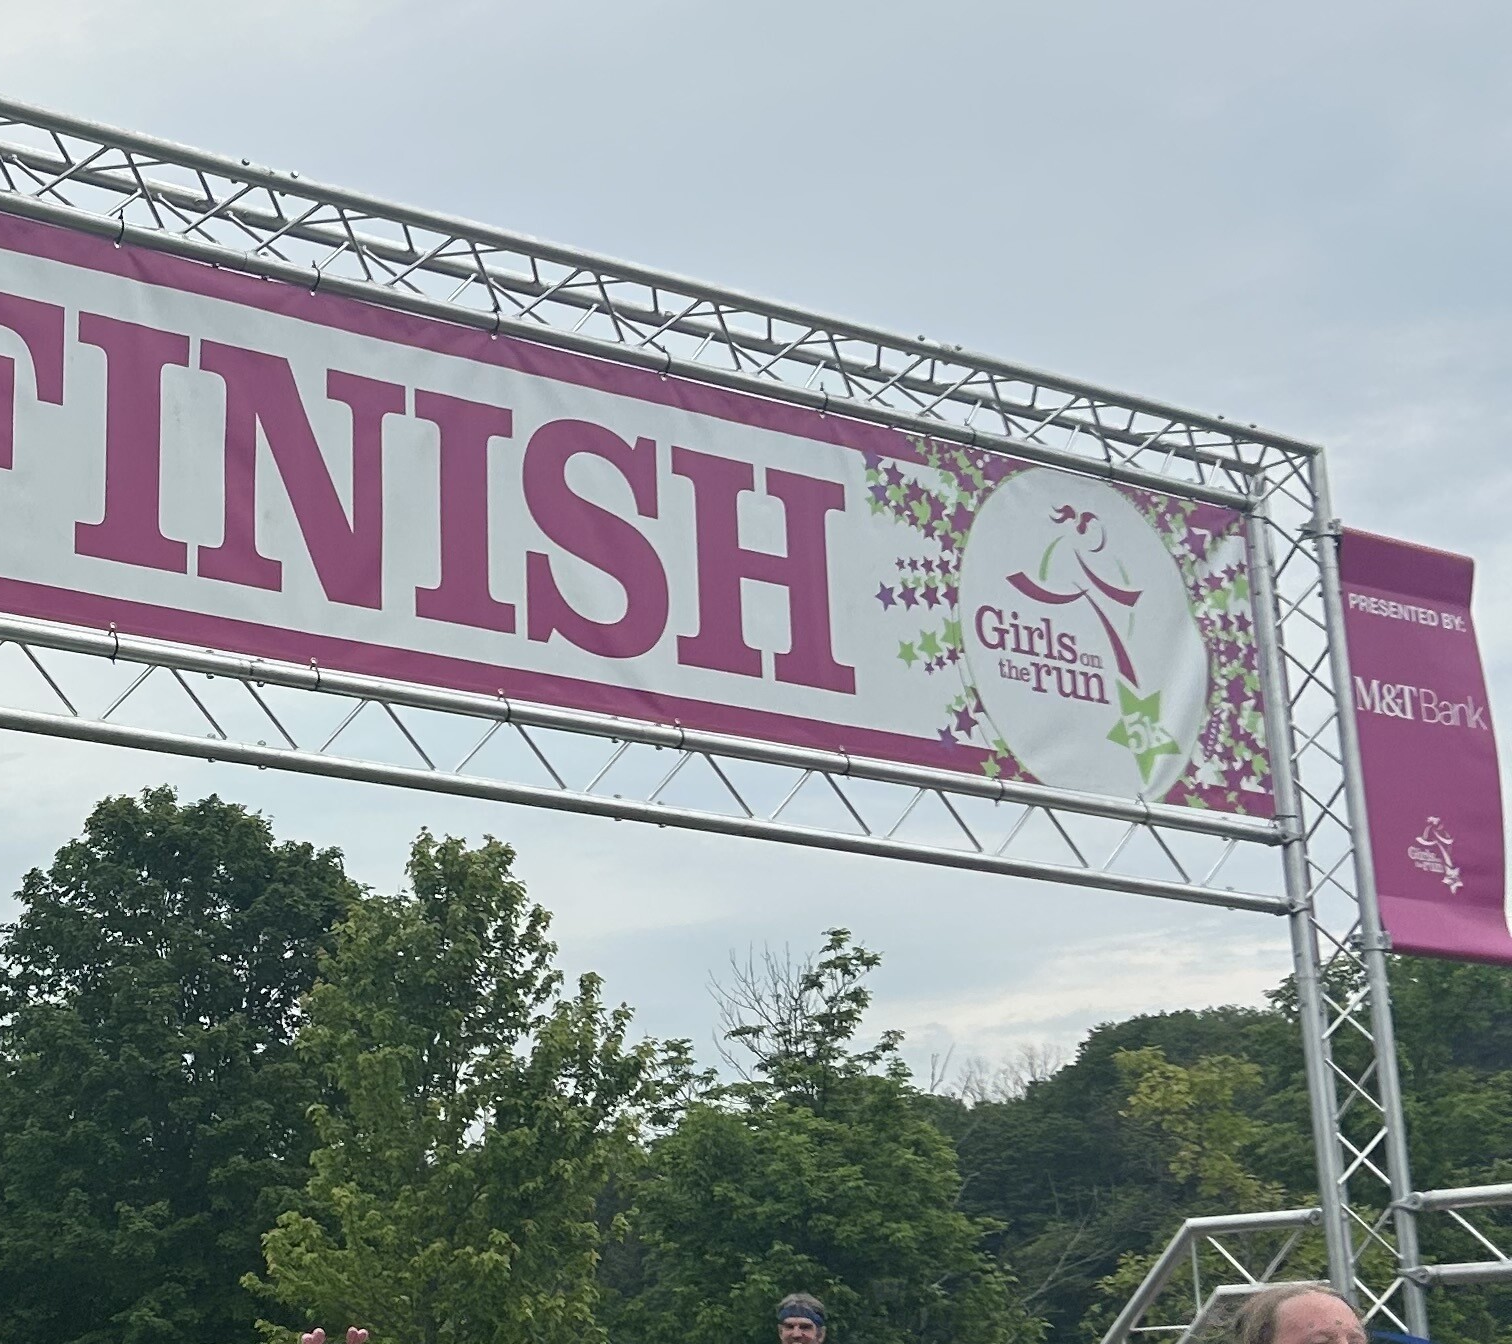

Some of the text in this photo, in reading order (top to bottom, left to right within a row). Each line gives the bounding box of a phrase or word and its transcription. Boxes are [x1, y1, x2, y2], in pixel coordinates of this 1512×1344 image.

[974, 605, 1104, 670] Girls on
[1348, 592, 1467, 633] PRESENTED BY:
[998, 658, 1110, 705] the run
[1353, 675, 1488, 731] M&T Bank
